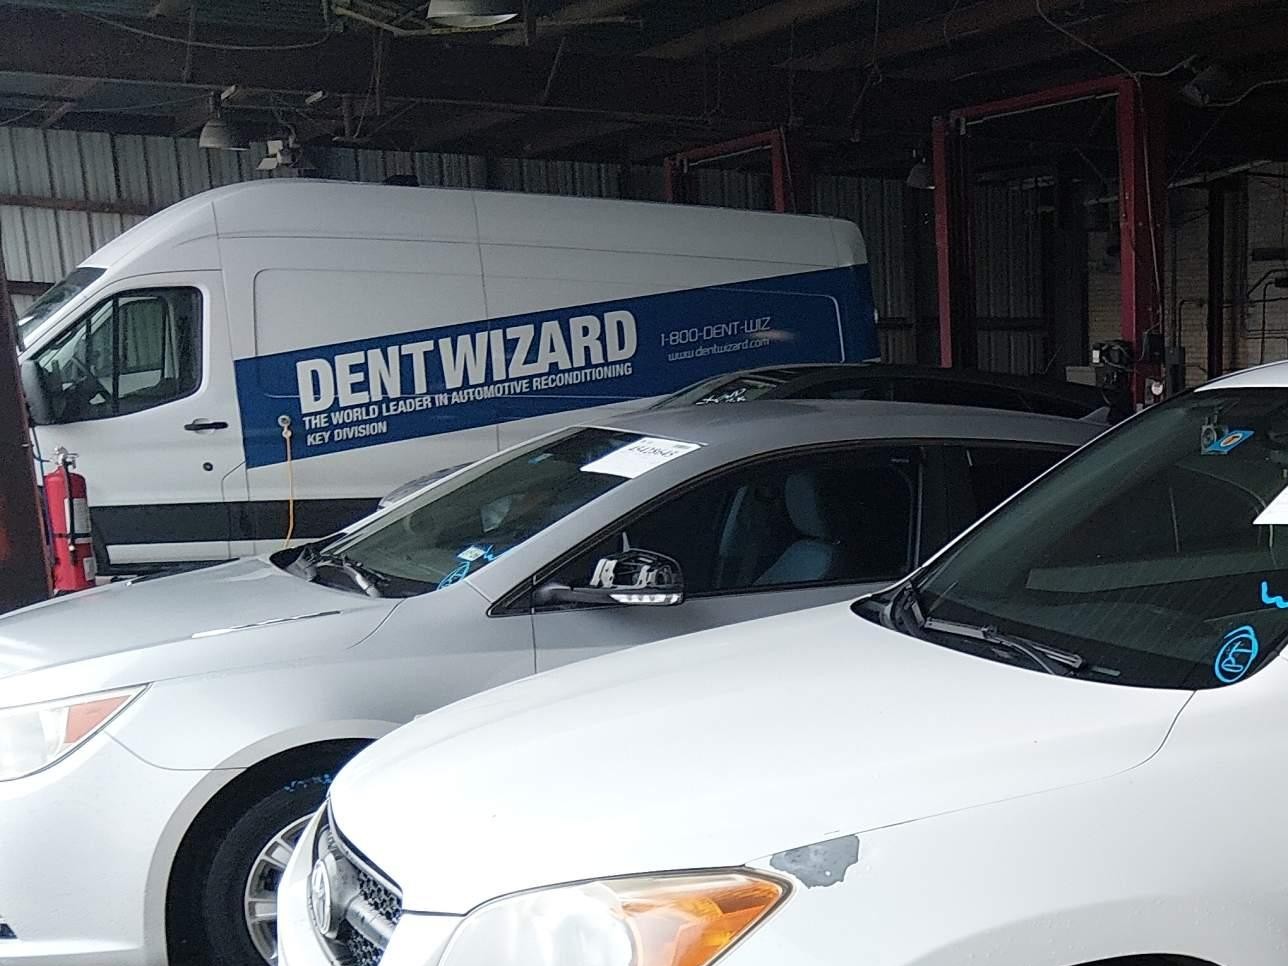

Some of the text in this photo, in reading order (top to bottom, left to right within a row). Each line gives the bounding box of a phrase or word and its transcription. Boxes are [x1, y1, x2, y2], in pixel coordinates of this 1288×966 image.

[660, 316, 771, 346] 1-800-DENT-WIZ
[296, 310, 637, 414] DENT WIZARD
[302, 362, 633, 430] THE WORLD LEADER IN AUTOMOTIVE RECONDITIONING
[307, 421, 388, 446] KEY DIVISION
